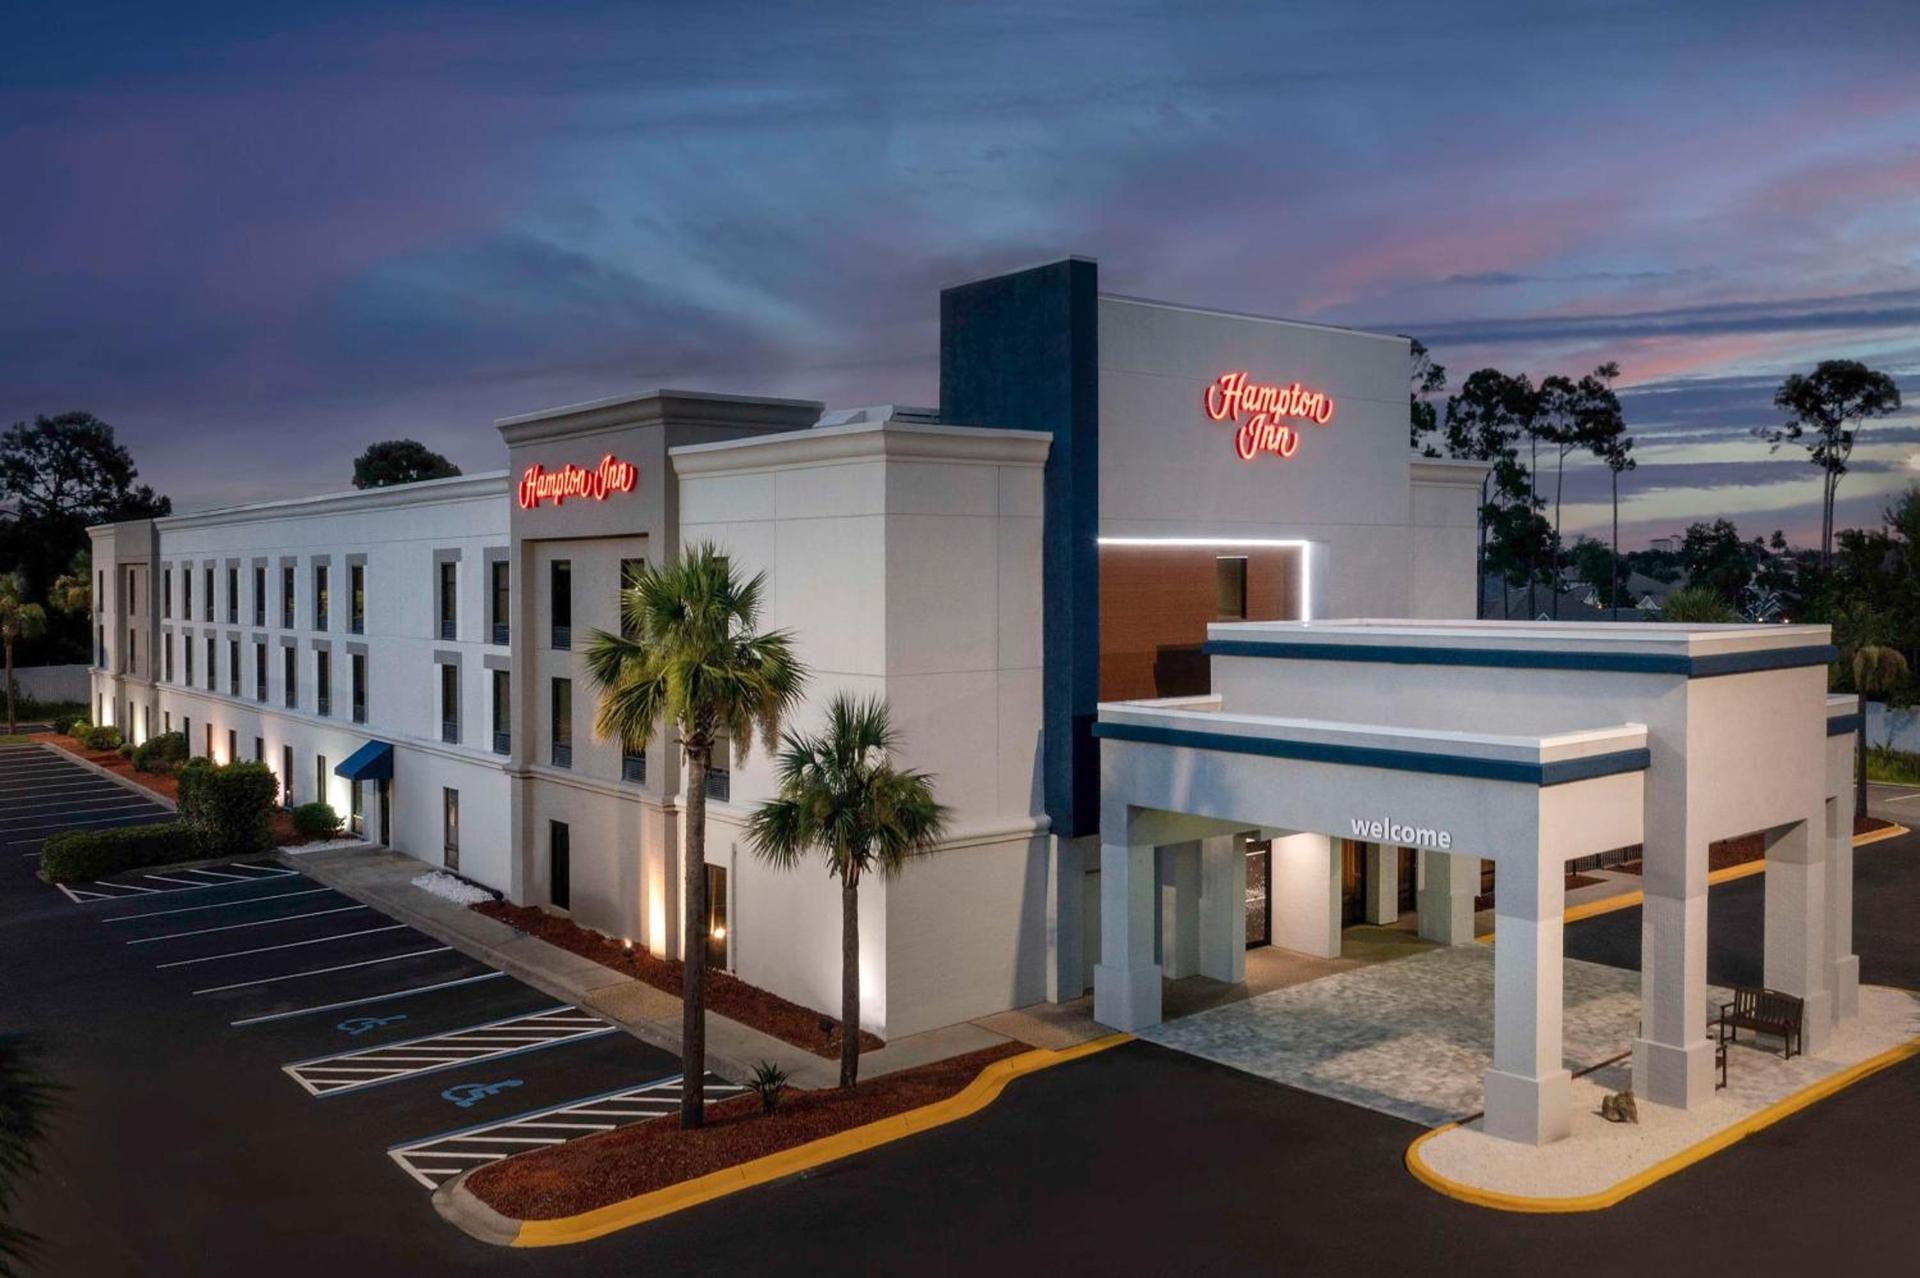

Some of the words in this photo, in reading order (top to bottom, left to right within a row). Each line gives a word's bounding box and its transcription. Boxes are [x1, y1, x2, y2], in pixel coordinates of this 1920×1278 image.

[1205, 372, 1333, 424] Hampton
[1236, 412, 1299, 460] Inn
[519, 464, 594, 509] Hampton
[594, 454, 637, 501] Inn
[1351, 816, 1453, 849] welcome
